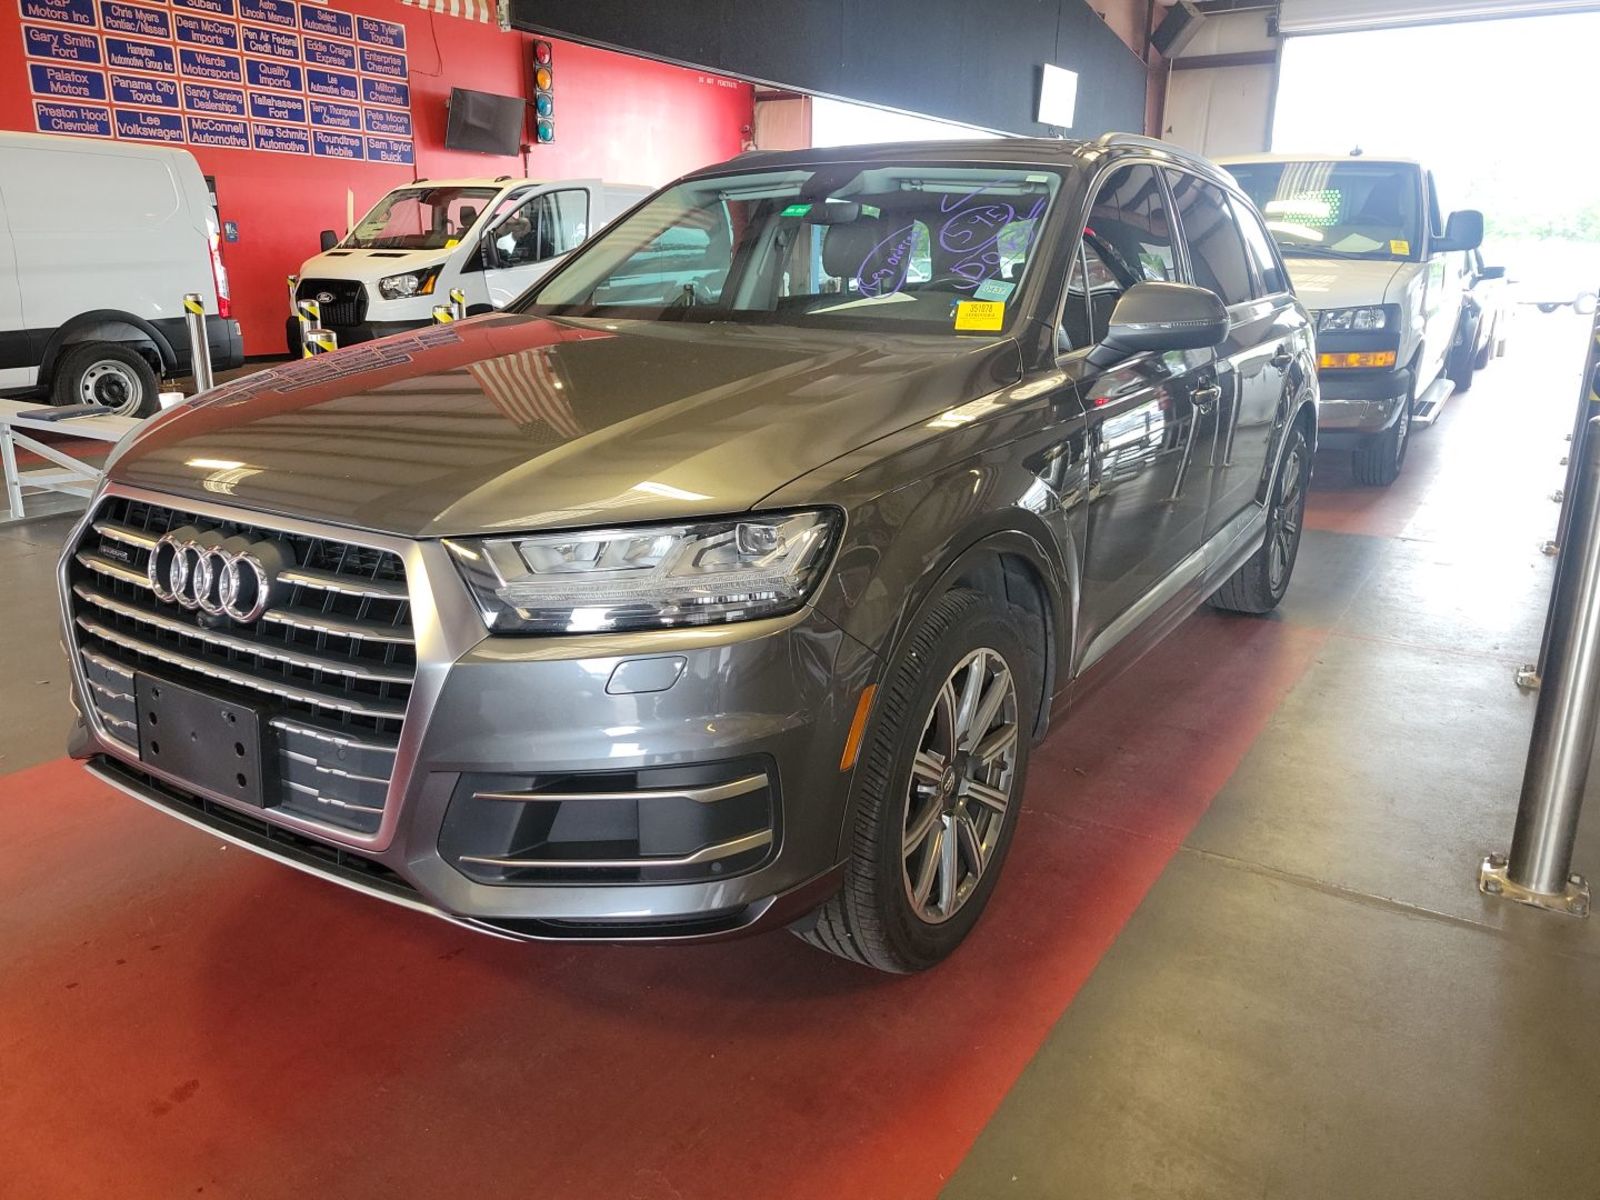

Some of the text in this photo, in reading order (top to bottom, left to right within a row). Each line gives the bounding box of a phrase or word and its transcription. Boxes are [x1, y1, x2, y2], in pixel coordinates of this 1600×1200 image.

[187, 0, 221, 11] Subaru
[259, 0, 277, 10] Astro
[28, 3, 89, 23] Motors Inc
[112, 5, 159, 23] Chris Myers
[242, 6, 294, 25] Lincoln Mercury
[318, 10, 336, 22] Select
[177, 16, 235, 37] Dean McCrary
[304, 19, 351, 36] Automotive LLC
[363, 21, 399, 35] Bob Tyler
[30, 29, 95, 48] Gary Smith
[191, 30, 224, 45] Imports
[243, 28, 298, 47] Pen Air Federal
[370, 32, 394, 45] Toyota
[52, 45, 78, 58] Ford
[126, 43, 155, 57] Hampton
[250, 41, 294, 56] Credit Union
[306, 40, 327, 52] Eddie
[111, 53, 173, 71] Automotive Group Inc
[195, 53, 226, 67] Wards
[316, 52, 346, 66] Express
[364, 51, 401, 65] Enterprise
[183, 62, 239, 80] Motorsports
[259, 63, 289, 79] Quality
[367, 62, 401, 75] Chevrolet
[47, 68, 89, 84] Palafox
[259, 74, 291, 88] Imports
[328, 74, 338, 84] Lee
[50, 81, 89, 96] Motors
[112, 76, 175, 95] Panama City
[185, 86, 210, 99] Sandy
[311, 82, 356, 98] Automotive Group
[375, 82, 396, 93] Milton
[130, 90, 162, 104] Toyota
[252, 94, 302, 110] Tallahassee
[370, 91, 403, 104] Chevrolet
[193, 98, 237, 113] Dealerships
[311, 102, 359, 117] Terry Thompson
[38, 105, 108, 121] Preston Hood
[140, 113, 160, 125] Lee
[269, 108, 288, 118] Ford
[322, 114, 350, 126] Chevrolet
[366, 110, 408, 124] Pete Moore
[51, 118, 99, 132] Chevrolet
[118, 122, 183, 140] Volkswagen
[192, 119, 244, 133] McConnell
[372, 121, 405, 133] Chevrolet
[192, 132, 247, 146] Automotive
[254, 125, 308, 140] Mike Schmitz
[317, 132, 359, 146] Roundtree
[260, 138, 305, 152] Automotive
[326, 145, 353, 157] Mobile
[369, 139, 411, 152] Sam Taylor
[380, 150, 402, 161] Buick
